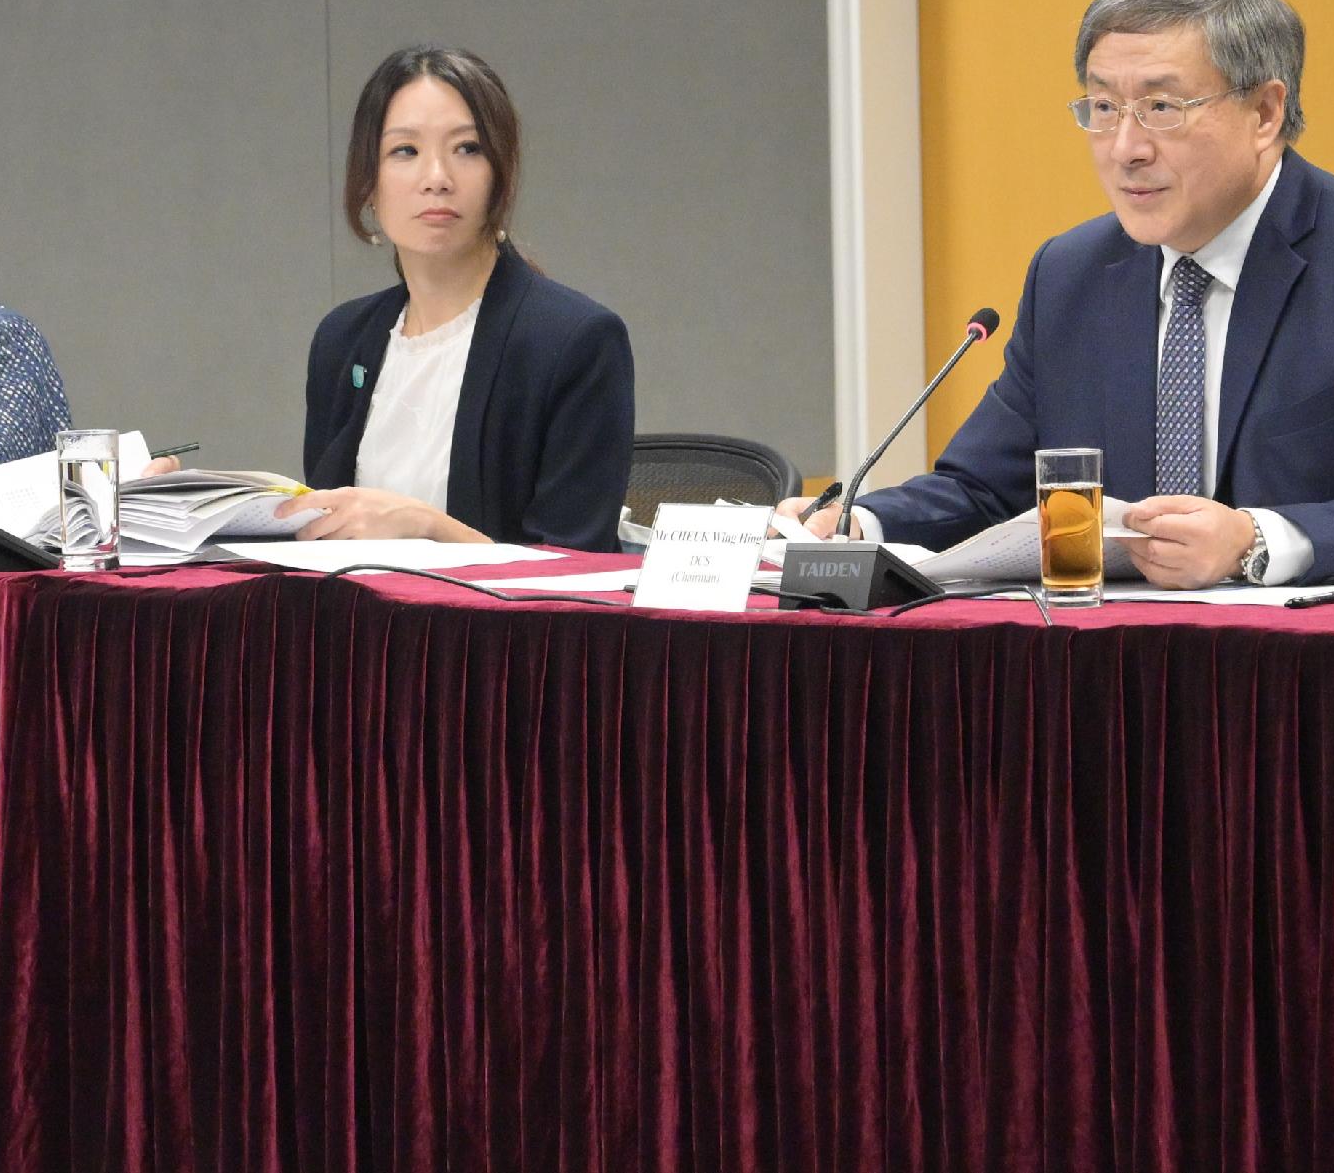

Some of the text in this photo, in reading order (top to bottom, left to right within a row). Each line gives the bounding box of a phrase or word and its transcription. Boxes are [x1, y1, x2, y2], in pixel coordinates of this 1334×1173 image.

[653, 529, 763, 546] Mr CHEUK Wing Hing
[689, 555, 712, 567] DCS
[798, 561, 861, 578] TAIDEN
[671, 571, 721, 585] (Chairman)
